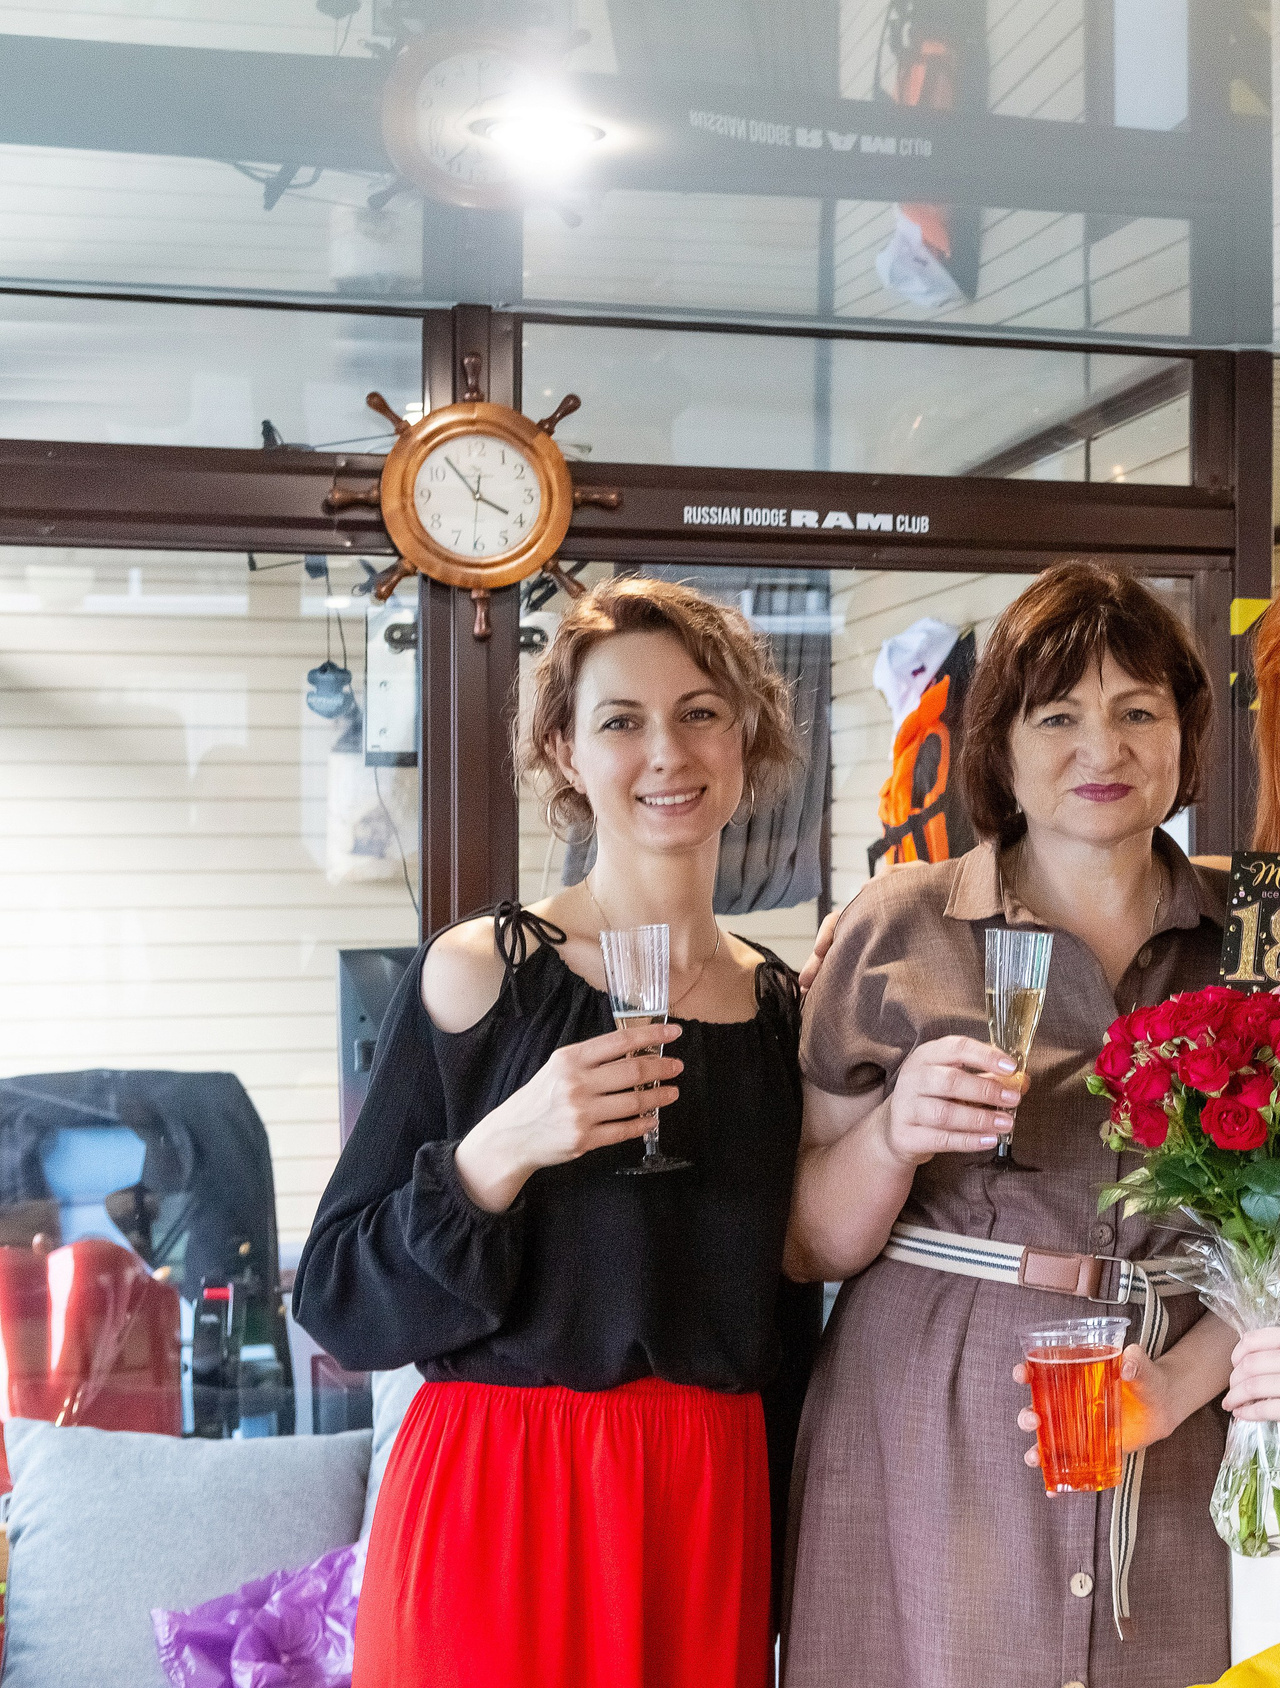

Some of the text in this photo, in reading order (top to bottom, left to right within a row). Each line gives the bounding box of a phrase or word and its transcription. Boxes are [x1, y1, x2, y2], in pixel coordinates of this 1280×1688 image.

[467, 441, 486, 457] 12
[430, 466, 446, 482] 10
[514, 464, 526, 480] 2
[420, 487, 431, 504] 9
[523, 488, 534, 504] 3
[430, 513, 442, 529] 8
[513, 513, 526, 528] 4
[683, 506, 930, 534] RUSSIAN DODGE RAM CLUB
[451, 529, 462, 545] 7
[473, 536, 485, 552] 6
[498, 529, 509, 546] 5
